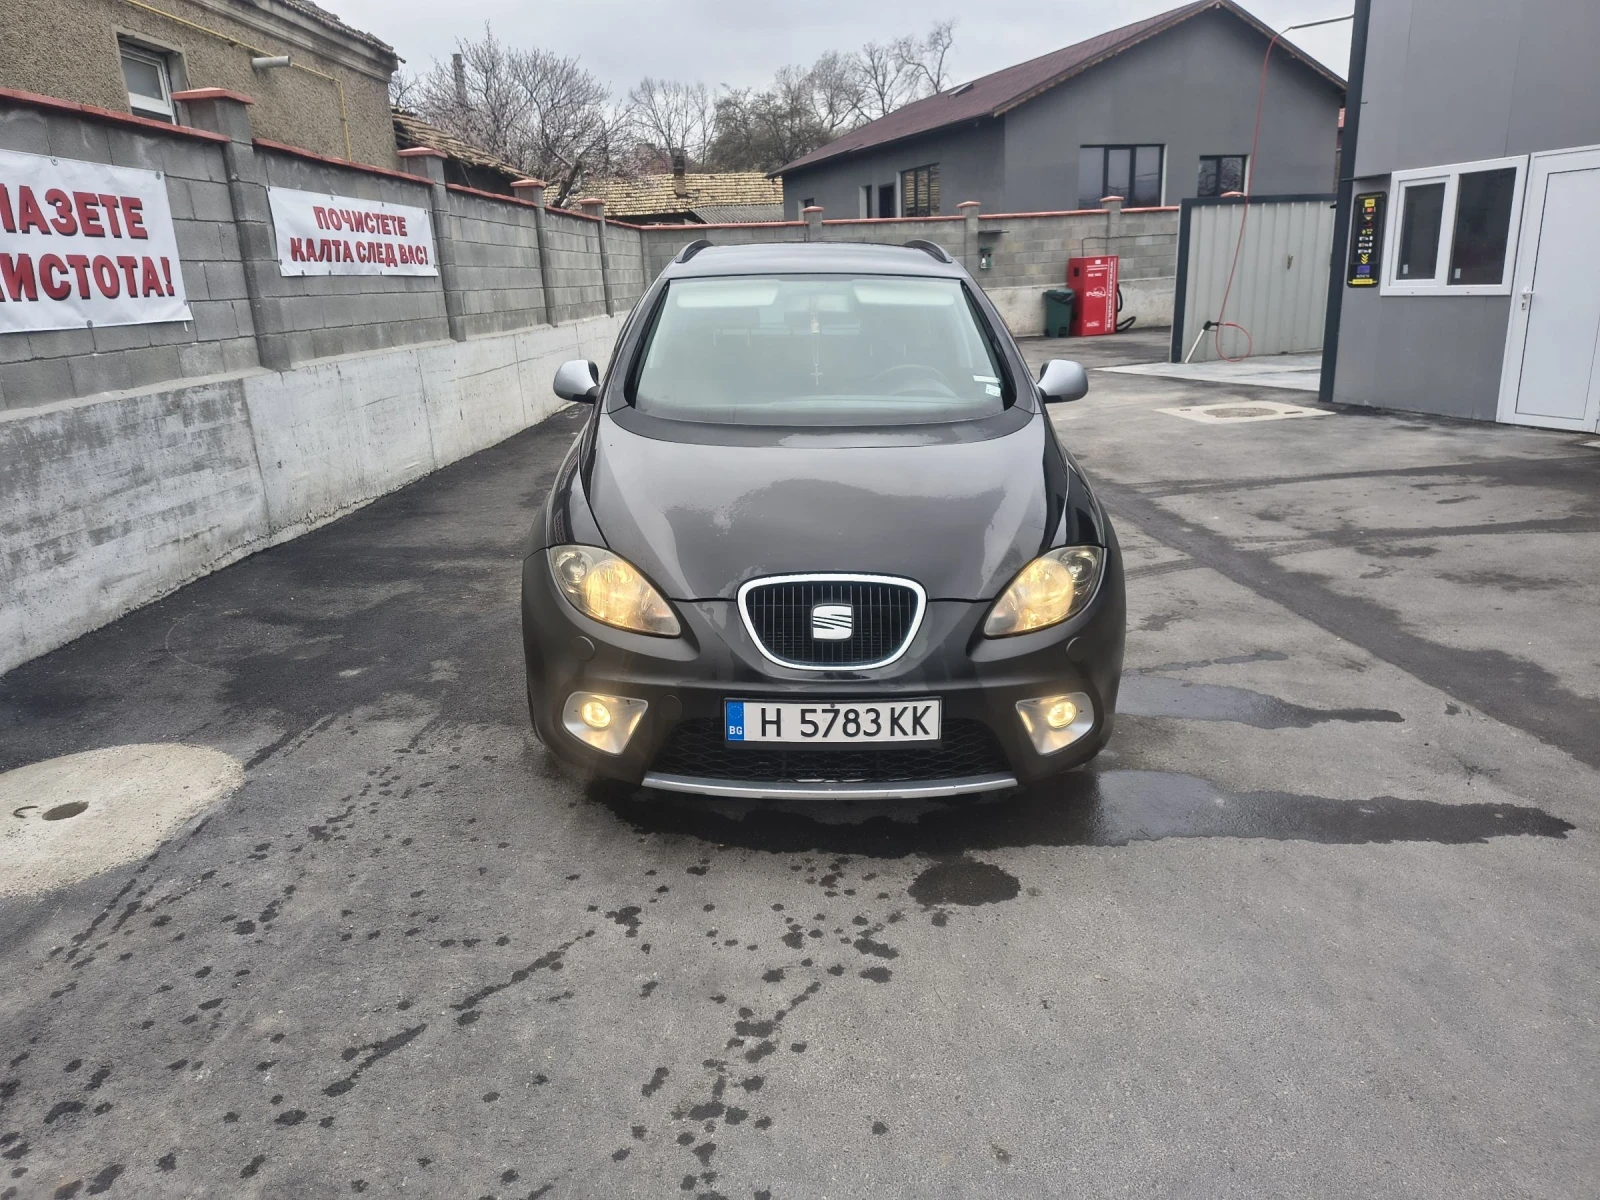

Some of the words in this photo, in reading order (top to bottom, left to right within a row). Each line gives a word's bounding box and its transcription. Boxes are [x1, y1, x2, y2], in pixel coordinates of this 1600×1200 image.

[313, 206, 408, 236] ПОЧИСТЕТЕ
[290, 237, 354, 263] КАЛТА
[355, 241, 398, 267] СЛЕД
[398, 244, 429, 265] ВАС!
[0, 253, 175, 302] ИСТОТА!
[729, 725, 743, 735] BG
[761, 707, 782, 737] H
